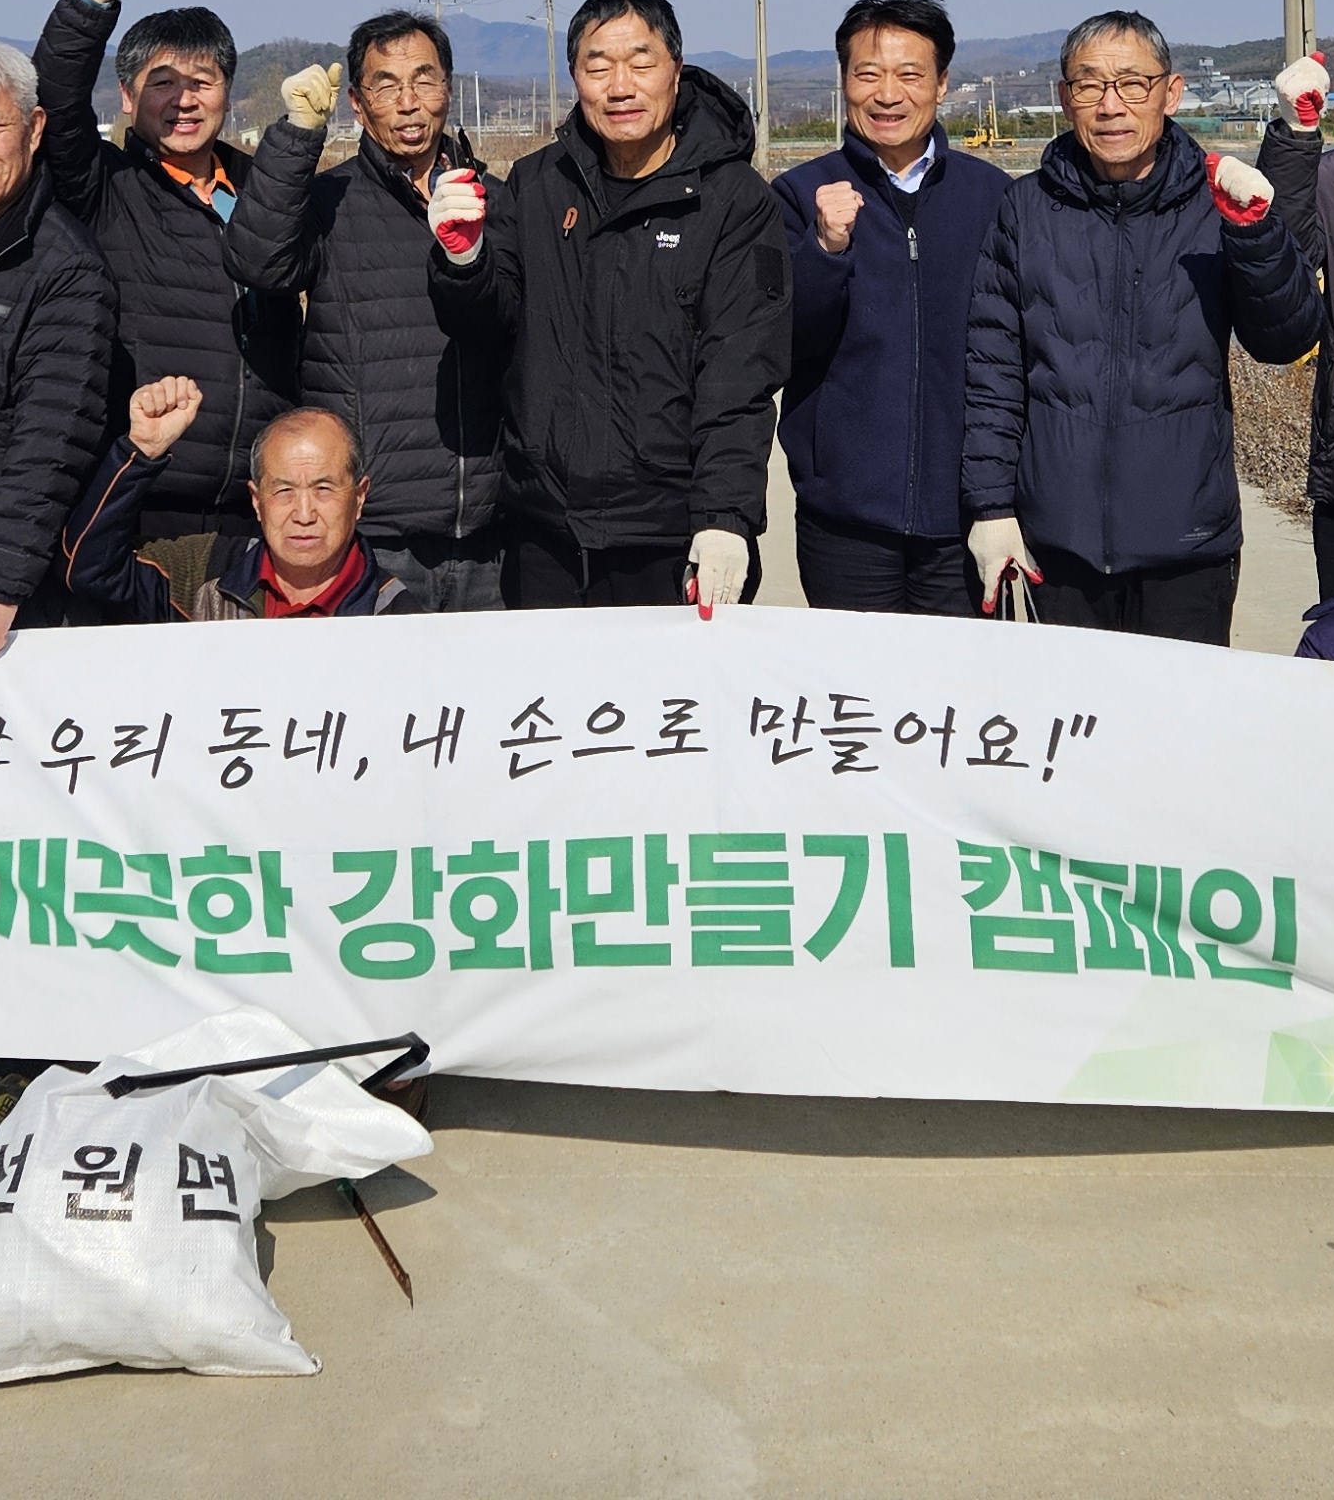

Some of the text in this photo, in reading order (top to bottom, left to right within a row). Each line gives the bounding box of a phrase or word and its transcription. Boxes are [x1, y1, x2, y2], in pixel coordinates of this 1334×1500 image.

[655, 231, 680, 244] Jeep
[40, 712, 173, 795] 우리
[208, 708, 369, 789] 동네,
[403, 705, 465, 768] 내
[499, 696, 709, 780] 손으로
[332, 833, 914, 979] 강화만들기
[958, 841, 1296, 989] 캠페인
